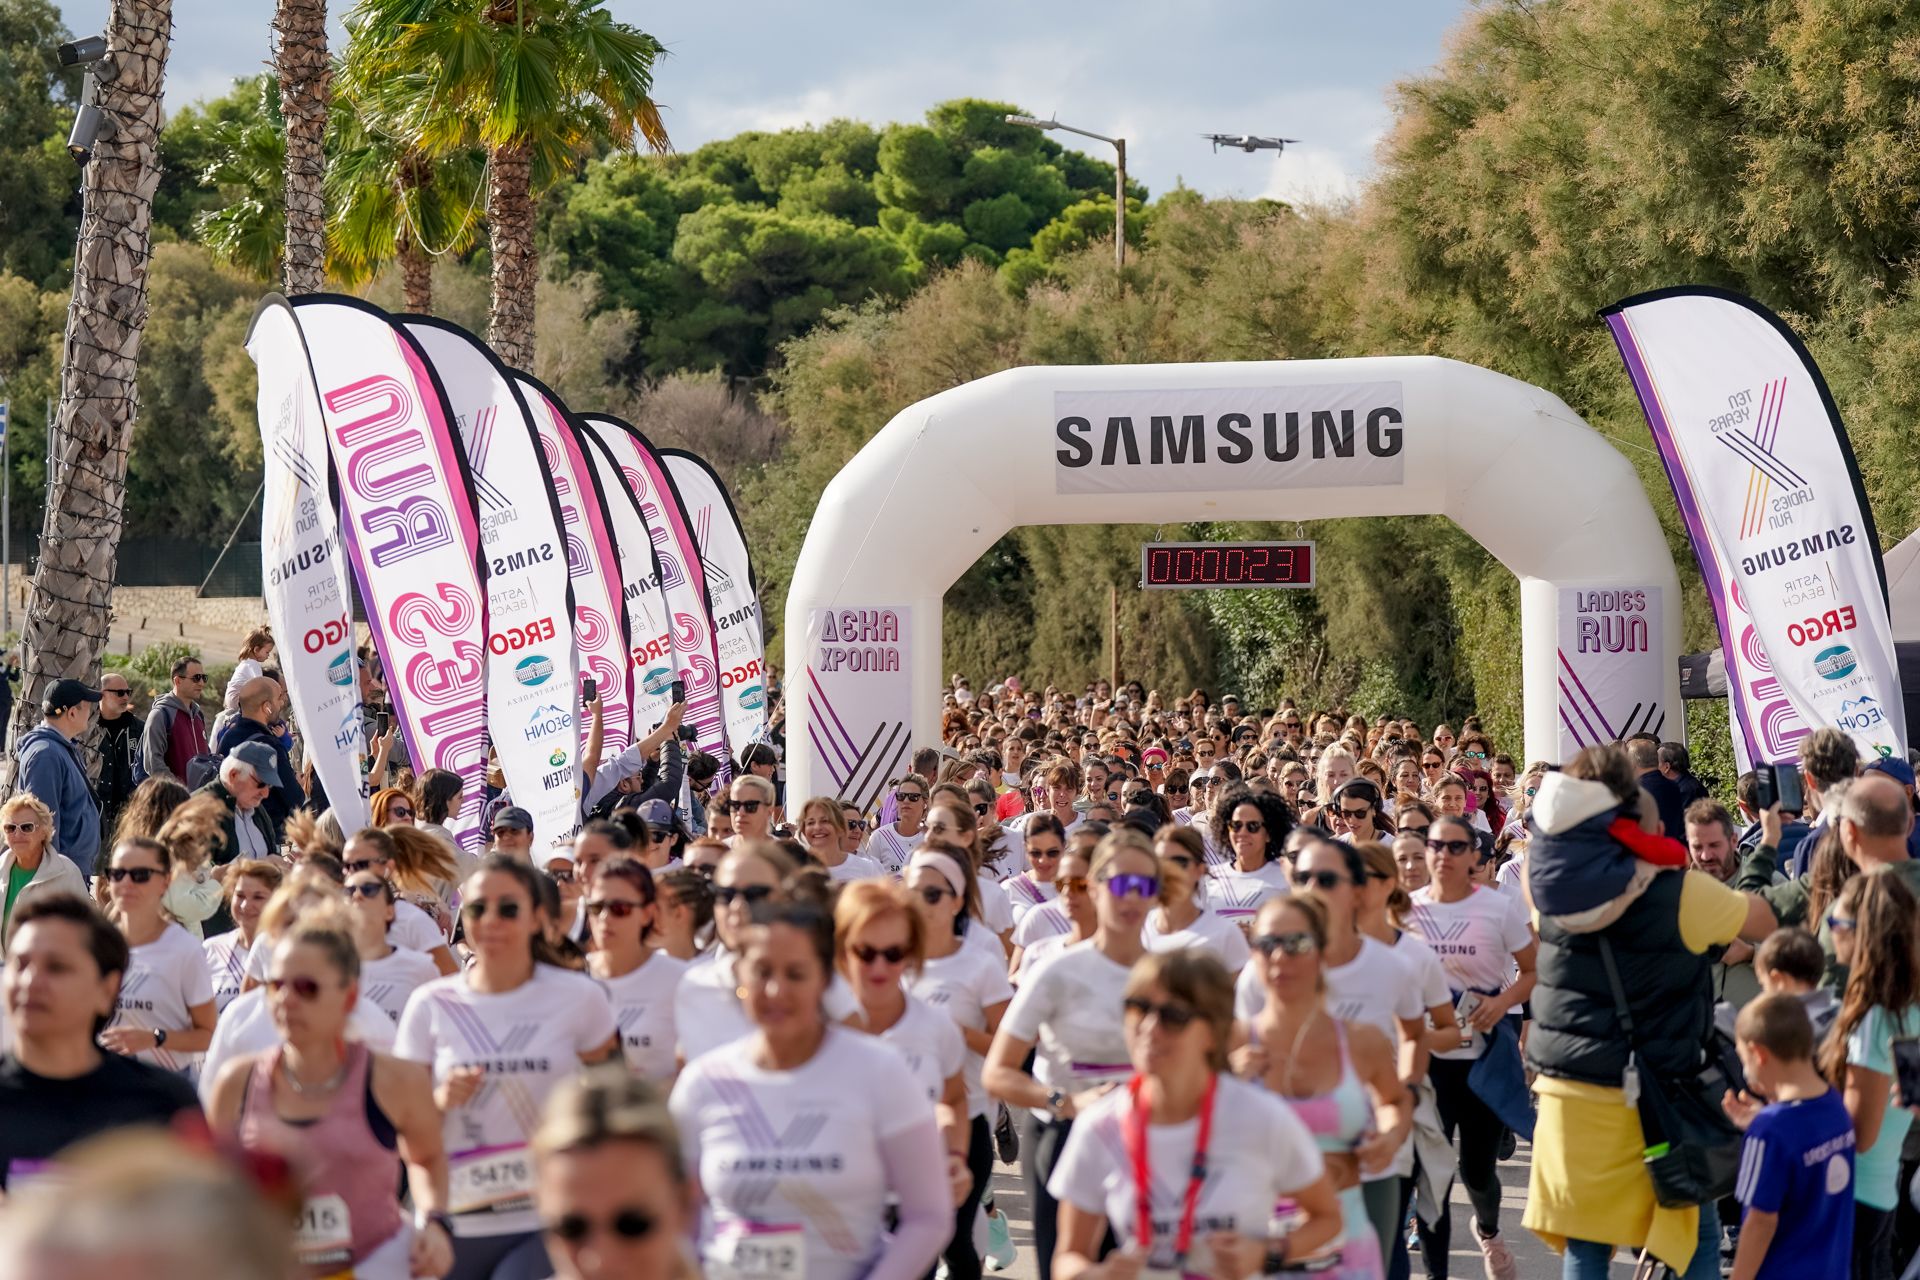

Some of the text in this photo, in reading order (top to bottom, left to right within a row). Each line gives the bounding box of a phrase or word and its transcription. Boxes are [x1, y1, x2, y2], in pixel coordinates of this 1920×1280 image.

[1056, 407, 1404, 468] SAMSUNG
[1151, 549, 1294, 583] 00:00:23
[1577, 589, 1646, 613] LADIES
[1577, 614, 1648, 653] RUN
